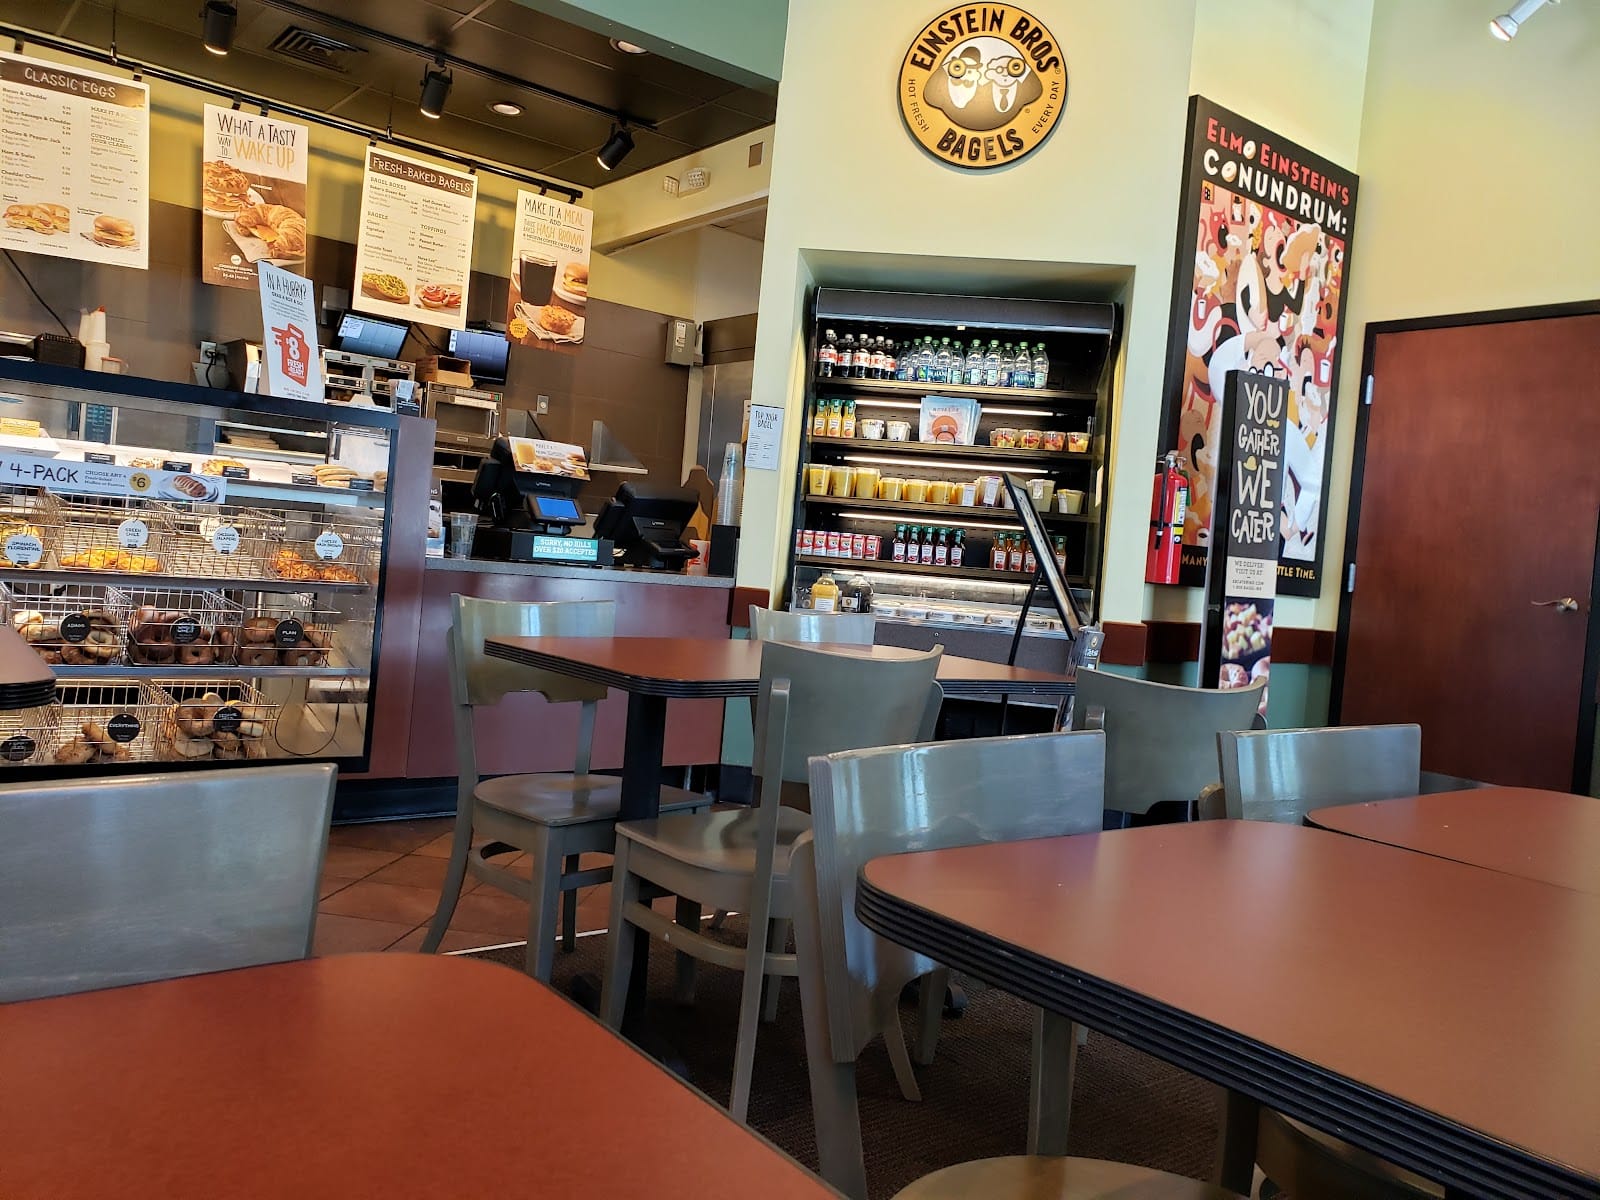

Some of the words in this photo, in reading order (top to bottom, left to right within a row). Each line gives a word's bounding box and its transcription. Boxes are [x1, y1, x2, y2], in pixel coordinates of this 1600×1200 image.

[910, 8, 1005, 72] EINSTEIN
[1010, 16, 1060, 72] BROS
[24, 67, 78, 91] CLASSIC
[82, 81, 117, 99] EGGS
[908, 79, 916, 98] HOT
[911, 102, 930, 132] FRESH
[1032, 104, 1054, 134] EVERY
[1050, 81, 1060, 100] DAY
[217, 112, 254, 138] WHAT
[258, 124, 265, 141] A
[268, 124, 296, 147] TASTY
[218, 136, 231, 147] WAY
[936, 128, 1024, 162] BAGELS
[221, 146, 228, 156] TO
[234, 137, 273, 165] WAKE
[276, 146, 295, 172] UP
[1206, 117, 1257, 160] ELMO
[1260, 143, 1350, 206] EINSTEIN'S
[372, 157, 437, 185] FRESH-BAKED
[439, 175, 472, 194] BAGELS
[1204, 148, 1348, 234] CONUNDRUM:
[524, 198, 548, 216] MAKE
[549, 205, 554, 217] IT
[557, 208, 562, 220] A
[564, 208, 584, 226] MEAL
[536, 223, 556, 240] HASH
[559, 229, 584, 246] BROWN
[266, 271, 274, 290] IN
[282, 276, 306, 300] HURRY?
[1244, 382, 1282, 424] YOU
[1238, 424, 1280, 456] GATHER
[10, 462, 79, 484] 4-PACK
[1238, 459, 1277, 508] WE
[1231, 509, 1274, 544] CATER
[1182, 554, 1208, 567] MANY
[1277, 564, 1294, 577] TTLE
[1296, 567, 1316, 580] TIME.
